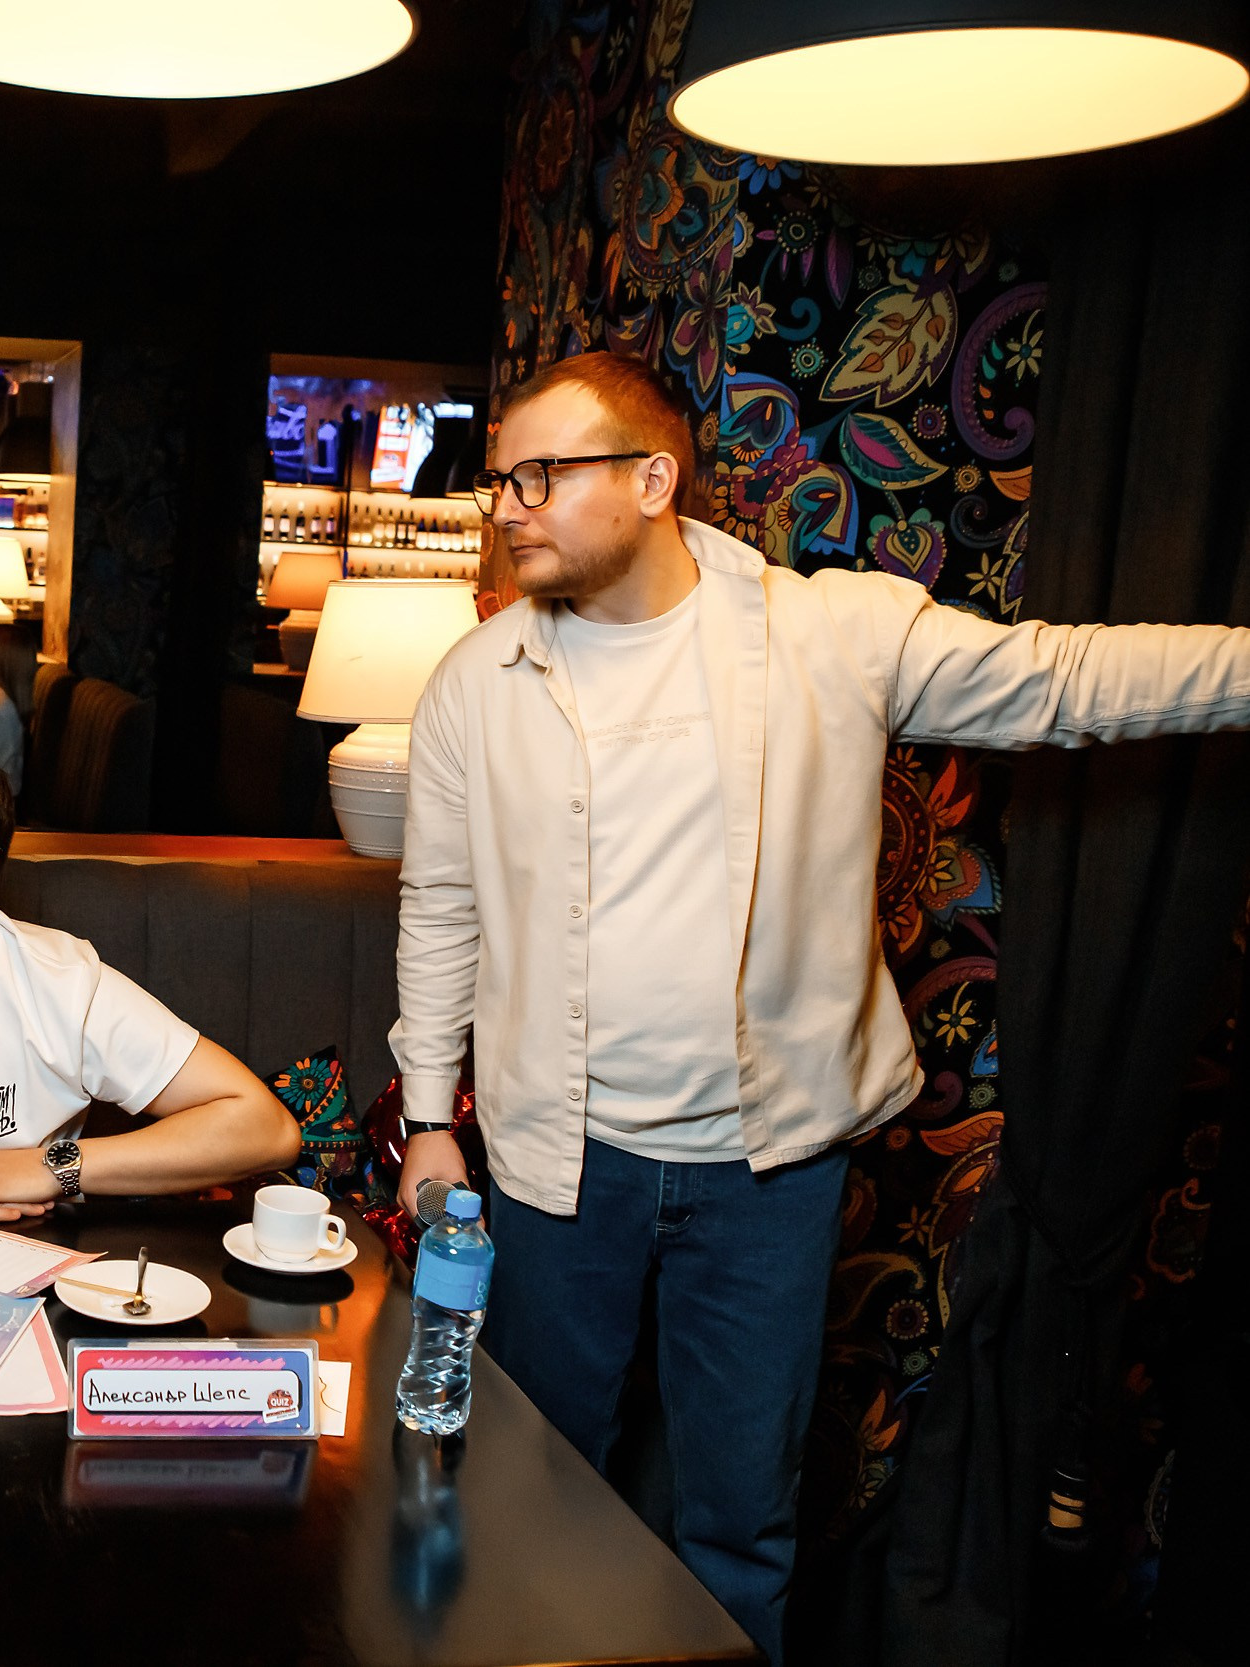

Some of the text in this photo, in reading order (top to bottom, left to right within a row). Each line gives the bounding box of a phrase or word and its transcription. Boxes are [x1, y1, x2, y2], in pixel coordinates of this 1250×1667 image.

[88, 1378, 251, 1406] Александр Шепс
[270, 1397, 290, 1407] QUIZ
